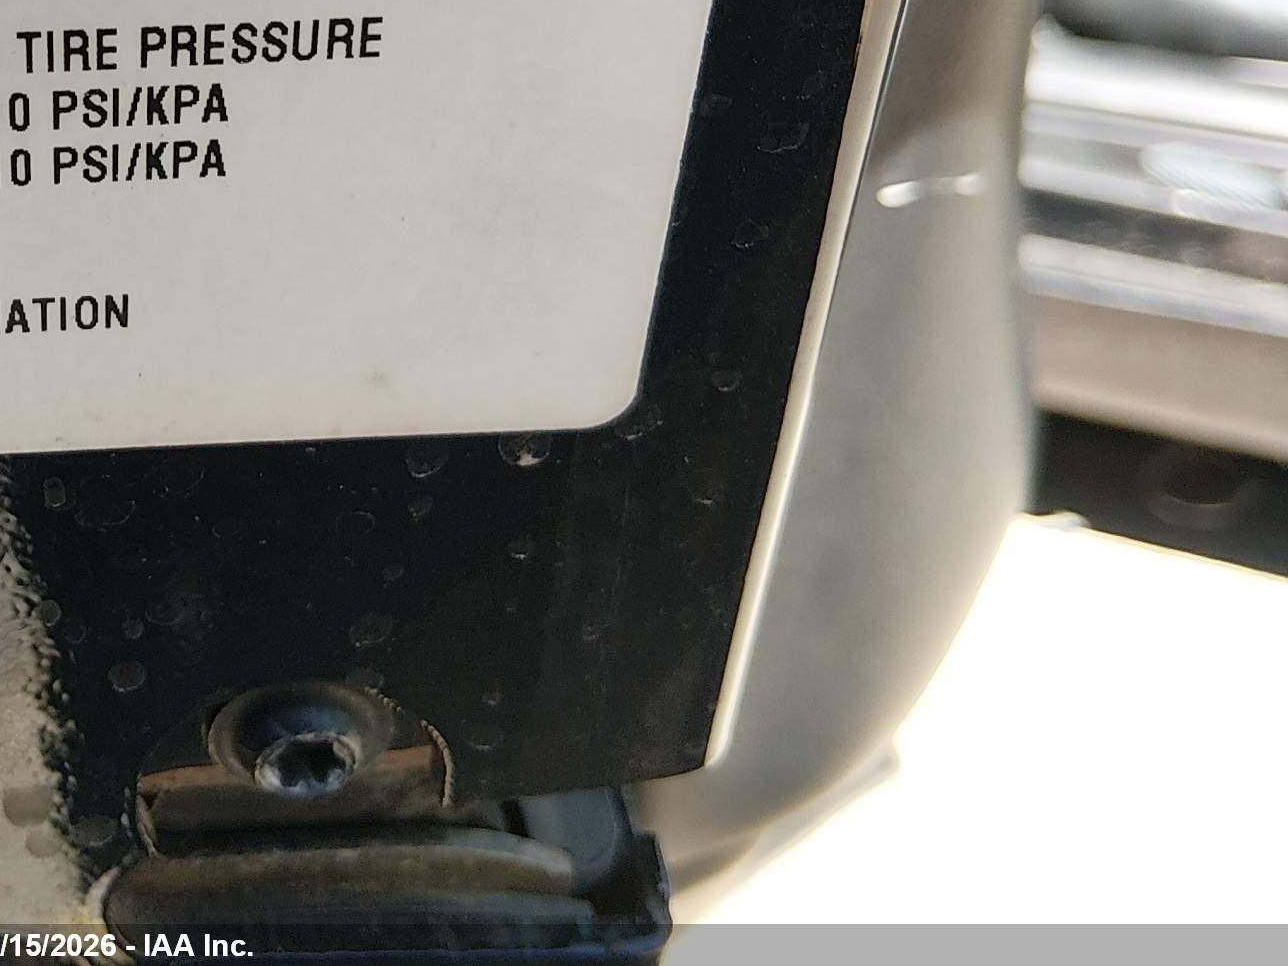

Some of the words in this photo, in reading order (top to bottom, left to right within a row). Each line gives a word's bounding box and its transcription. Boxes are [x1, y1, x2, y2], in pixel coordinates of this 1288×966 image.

[15, 27, 118, 75] TIRE
[140, 16, 384, 69] PRESSURE
[52, 82, 229, 131] PSI/KPA
[53, 138, 227, 185] PSI/KPA
